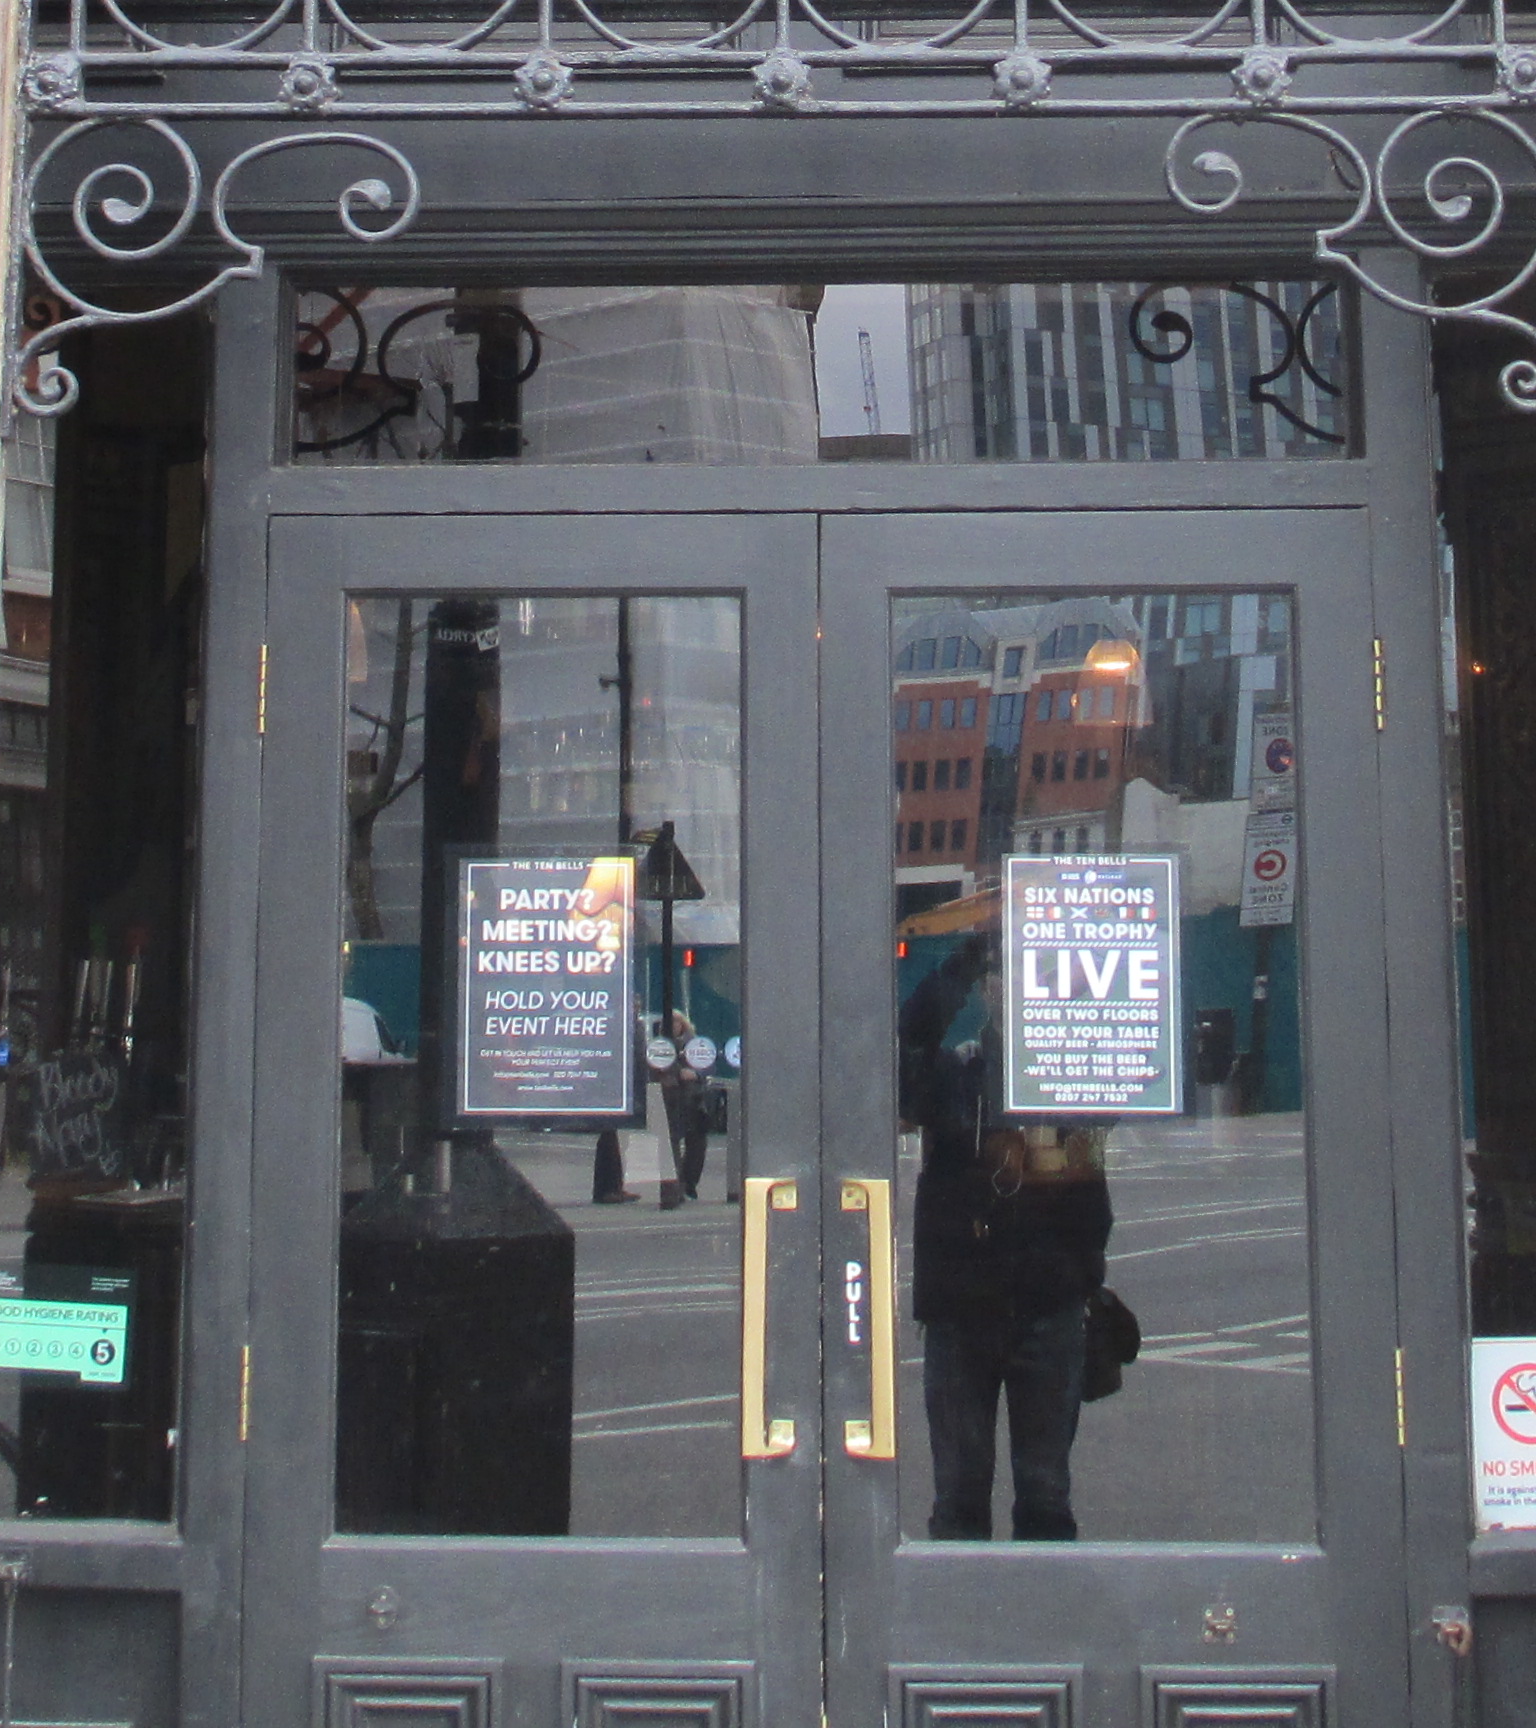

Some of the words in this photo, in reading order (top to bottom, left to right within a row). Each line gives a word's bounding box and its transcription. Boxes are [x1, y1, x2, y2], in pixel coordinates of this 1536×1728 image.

[513, 861, 531, 870] THE
[535, 861, 553, 870] TEN
[556, 861, 584, 870] BELLS
[1054, 856, 1073, 865] THE
[1076, 856, 1095, 865] TEN
[1098, 857, 1126, 865] BELLS
[500, 888, 595, 910] PARTY?
[1024, 887, 1057, 904] SIX
[1064, 887, 1155, 904] NATIONS
[482, 919, 612, 941] MEETING?
[1022, 922, 1066, 939] ONE
[1072, 923, 1157, 939] TROPHY
[478, 950, 560, 972] KNEES
[566, 950, 616, 973] UP?
[1023, 949, 1159, 999] LIVE
[485, 990, 544, 1010] HOLD
[549, 990, 609, 1010] YOUR
[1023, 1008, 1061, 1021] OVER
[1065, 1008, 1099, 1021] TWO
[1103, 1008, 1159, 1021] FLOORS
[485, 1016, 550, 1035] EVENT
[554, 1016, 608, 1035] HERE
[1024, 1025, 1067, 1038] BOOK
[1071, 1026, 1112, 1038] YOUR
[1117, 1026, 1159, 1039] TABLE
[1024, 1039, 1063, 1048] QUALITY
[1066, 1040, 1088, 1048] BEER
[1096, 1040, 1157, 1049] ATMOSPHERE
[1036, 1053, 1061, 1064] YOU
[1065, 1054, 1088, 1064] BUY
[1091, 1054, 1113, 1064] THE
[1116, 1054, 1146, 1064] BEER
[1065, 1065, 1088, 1076] GET
[1091, 1066, 1114, 1076] THE
[1055, 1093, 1079, 1102] 0207
[1082, 1093, 1100, 1102] 247
[845, 1261, 862, 1343] PULL
[24, 1308, 73, 1320] HYGIENE
[76, 1310, 119, 1323] RATING
[95, 1342, 110, 1363] 5
[1483, 1460, 1506, 1476] NO
